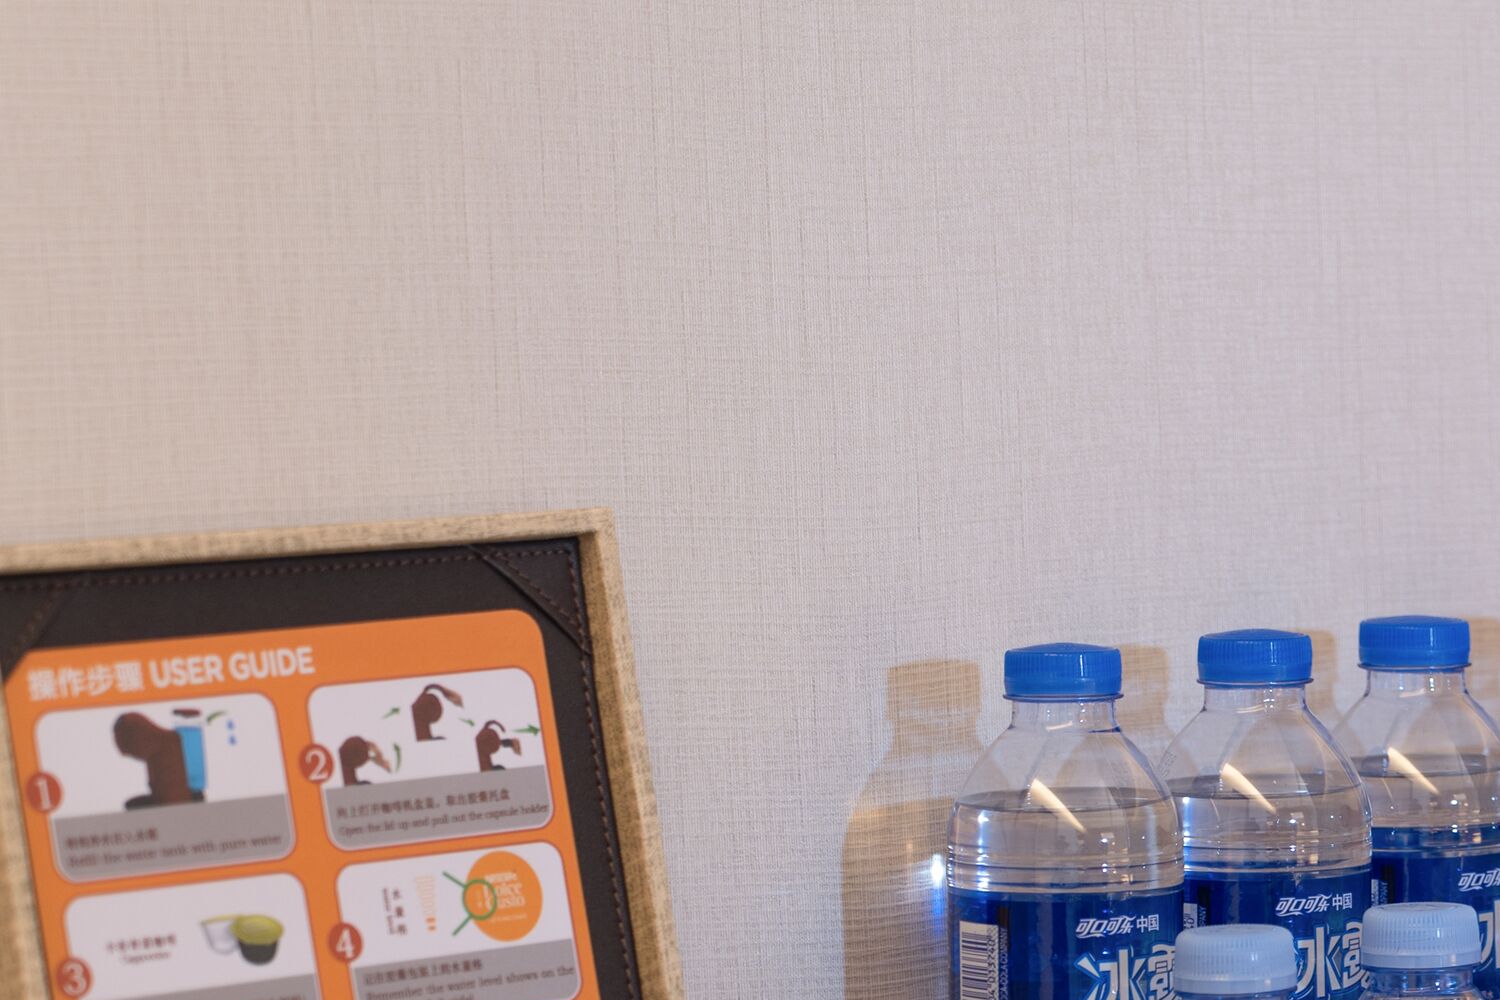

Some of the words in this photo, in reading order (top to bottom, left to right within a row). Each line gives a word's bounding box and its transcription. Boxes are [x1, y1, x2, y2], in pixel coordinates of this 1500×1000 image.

[149, 655, 225, 689] USER
[228, 646, 316, 681] GUIDE
[306, 750, 329, 782] 2
[36, 778, 51, 811] 1
[469, 810, 482, 821] the
[485, 807, 518, 820] capsule
[519, 803, 549, 816] holder
[1275, 892, 1352, 917] 可口可乐中国
[1075, 914, 1159, 939] 可口可乐中国
[335, 927, 355, 959] 4
[62, 961, 87, 997] 3
[426, 983, 444, 994] the
[447, 979, 477, 992] water
[479, 975, 503, 988] level
[506, 971, 539, 983] shows
[541, 970, 555, 980] on
[557, 965, 576, 976] the
